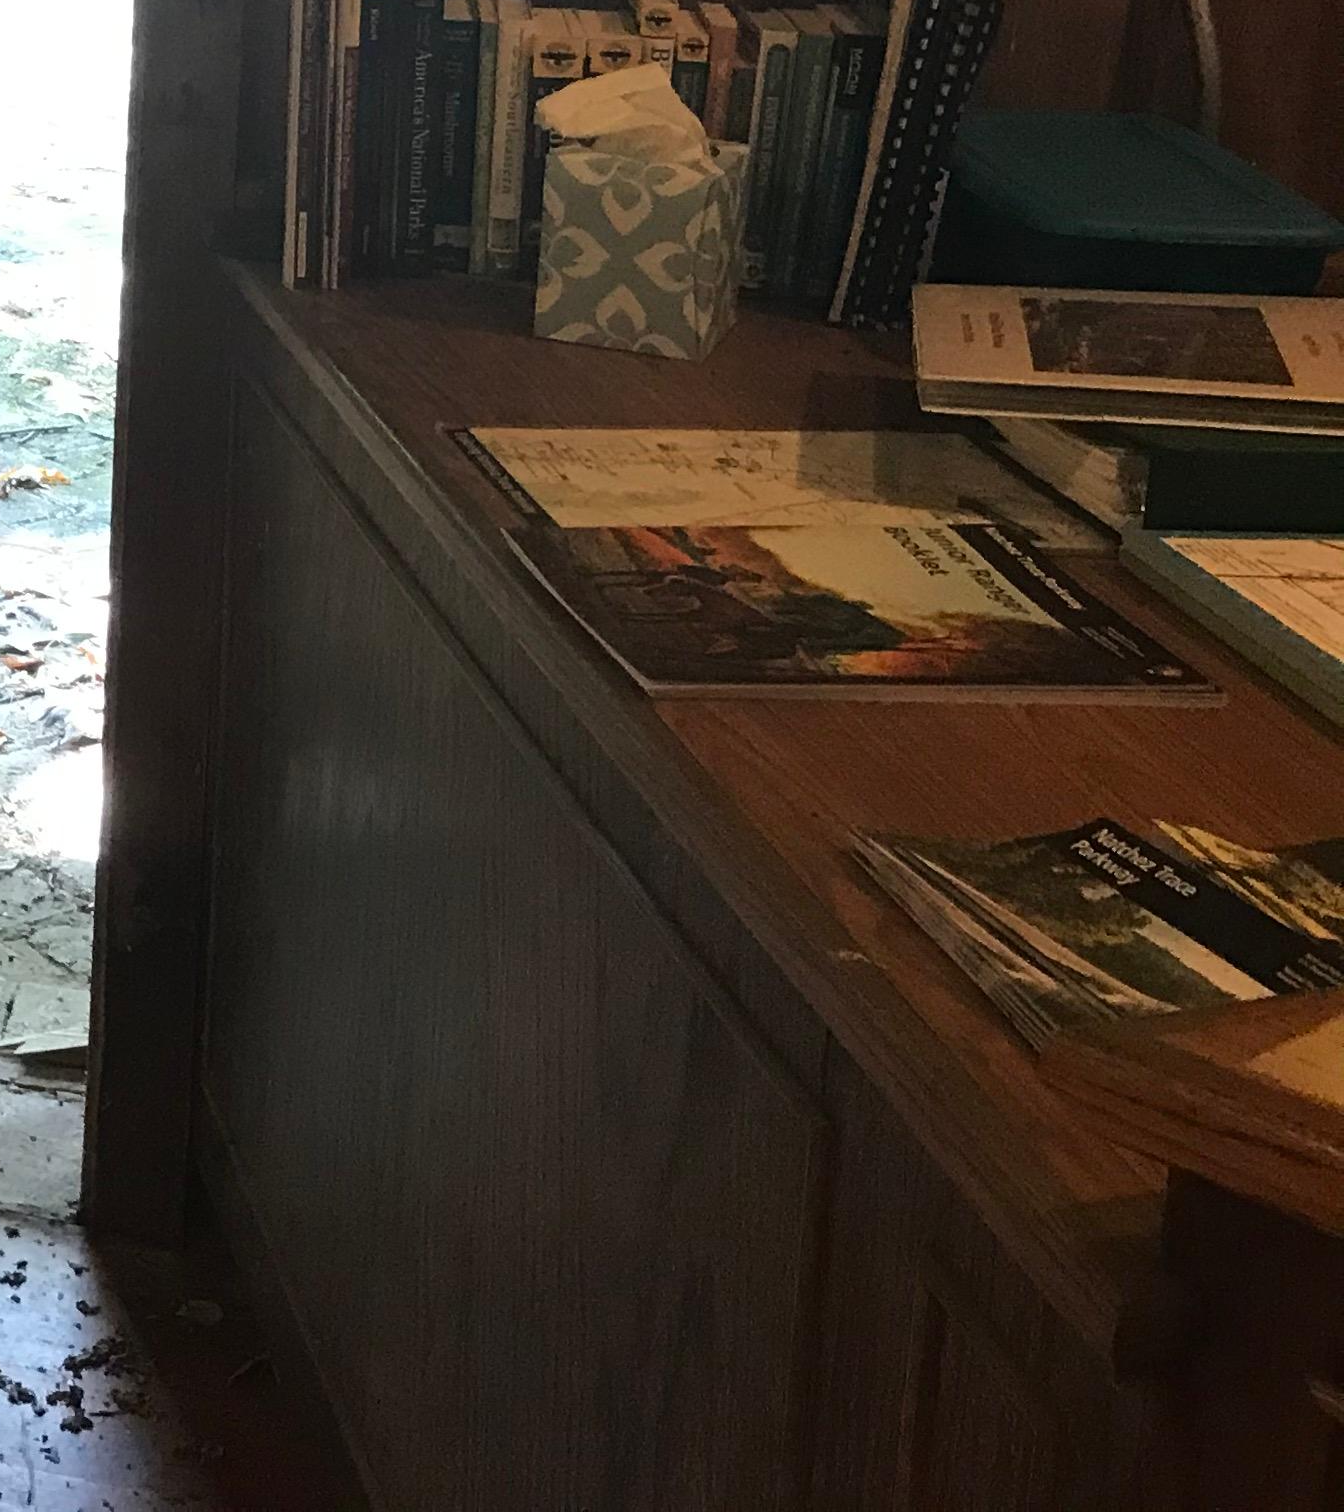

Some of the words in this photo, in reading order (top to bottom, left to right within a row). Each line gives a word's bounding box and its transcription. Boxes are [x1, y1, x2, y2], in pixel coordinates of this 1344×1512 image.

[412, 50, 433, 126] America's
[846, 47, 863, 95] MOON
[409, 128, 430, 195] National
[501, 91, 521, 194] Southeastern
[407, 196, 426, 241] Parks
[883, 525, 950, 577] Booklet
[920, 526, 974, 566] Junior
[1070, 839, 1141, 886] Parkway
[1091, 828, 1157, 872] Natchez
[1154, 864, 1199, 899] Trace
